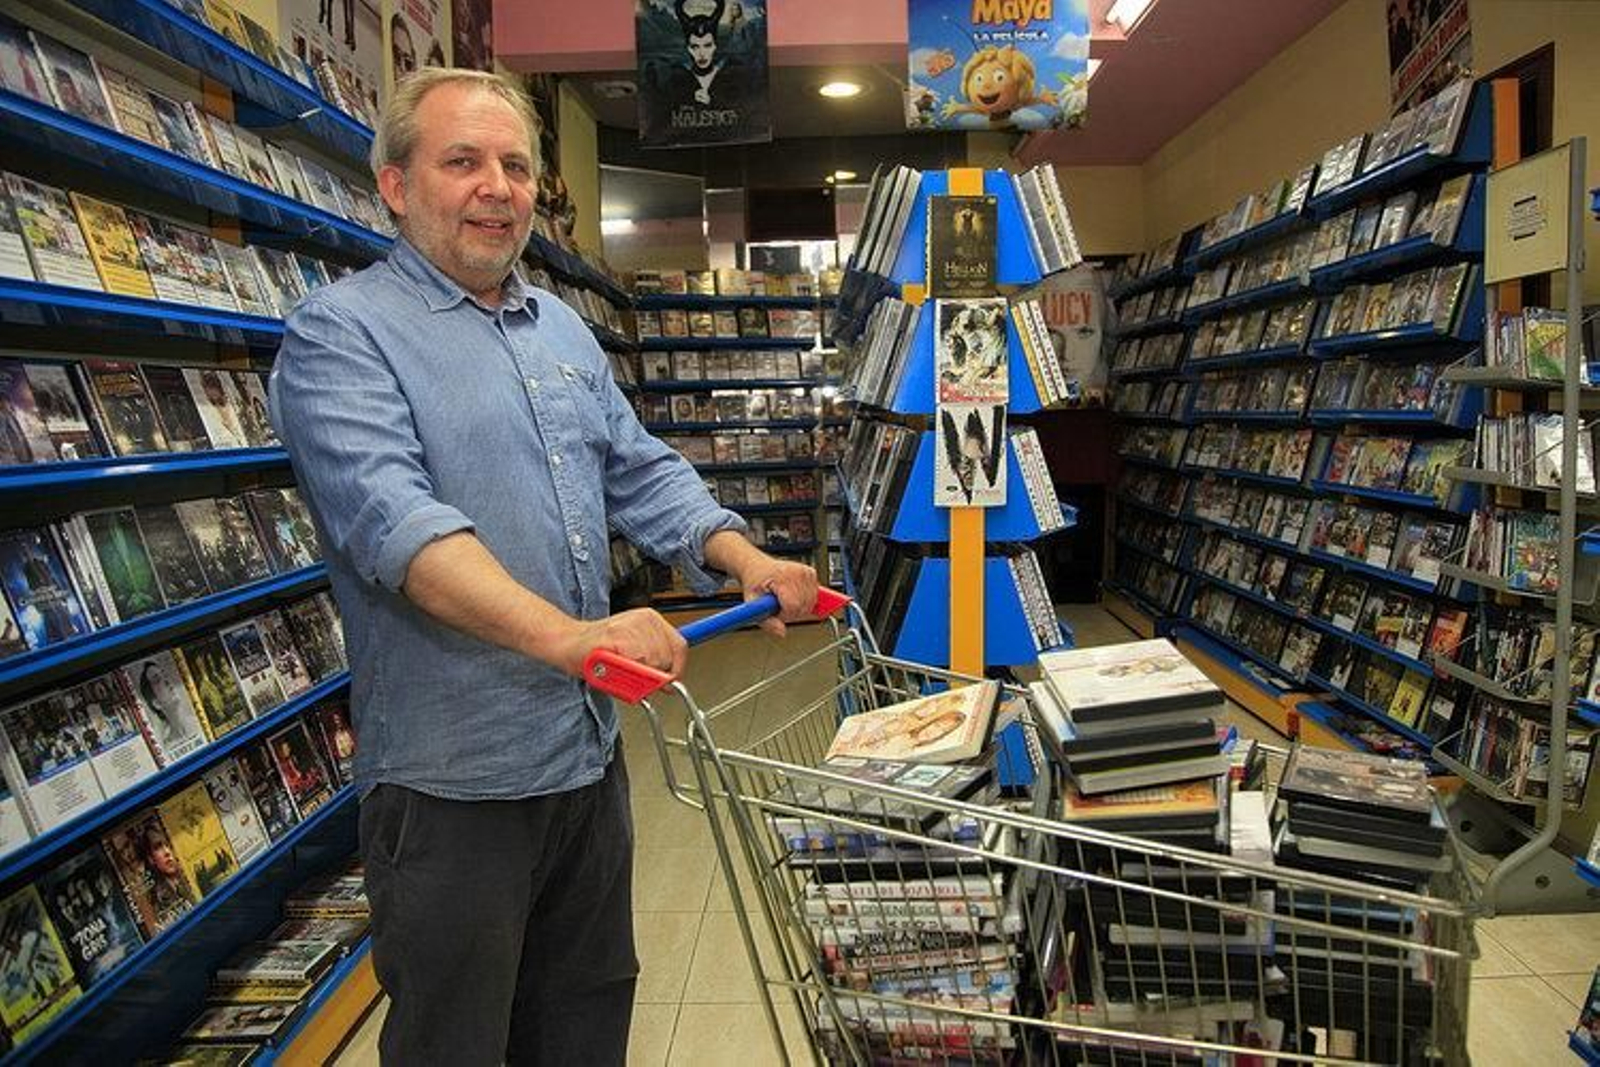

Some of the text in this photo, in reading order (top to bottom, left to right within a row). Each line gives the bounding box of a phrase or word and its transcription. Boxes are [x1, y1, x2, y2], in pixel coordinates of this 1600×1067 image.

[971, 0, 1052, 28] Maya
[974, 32, 990, 41] LA
[1042, 290, 1092, 325] LUCY
